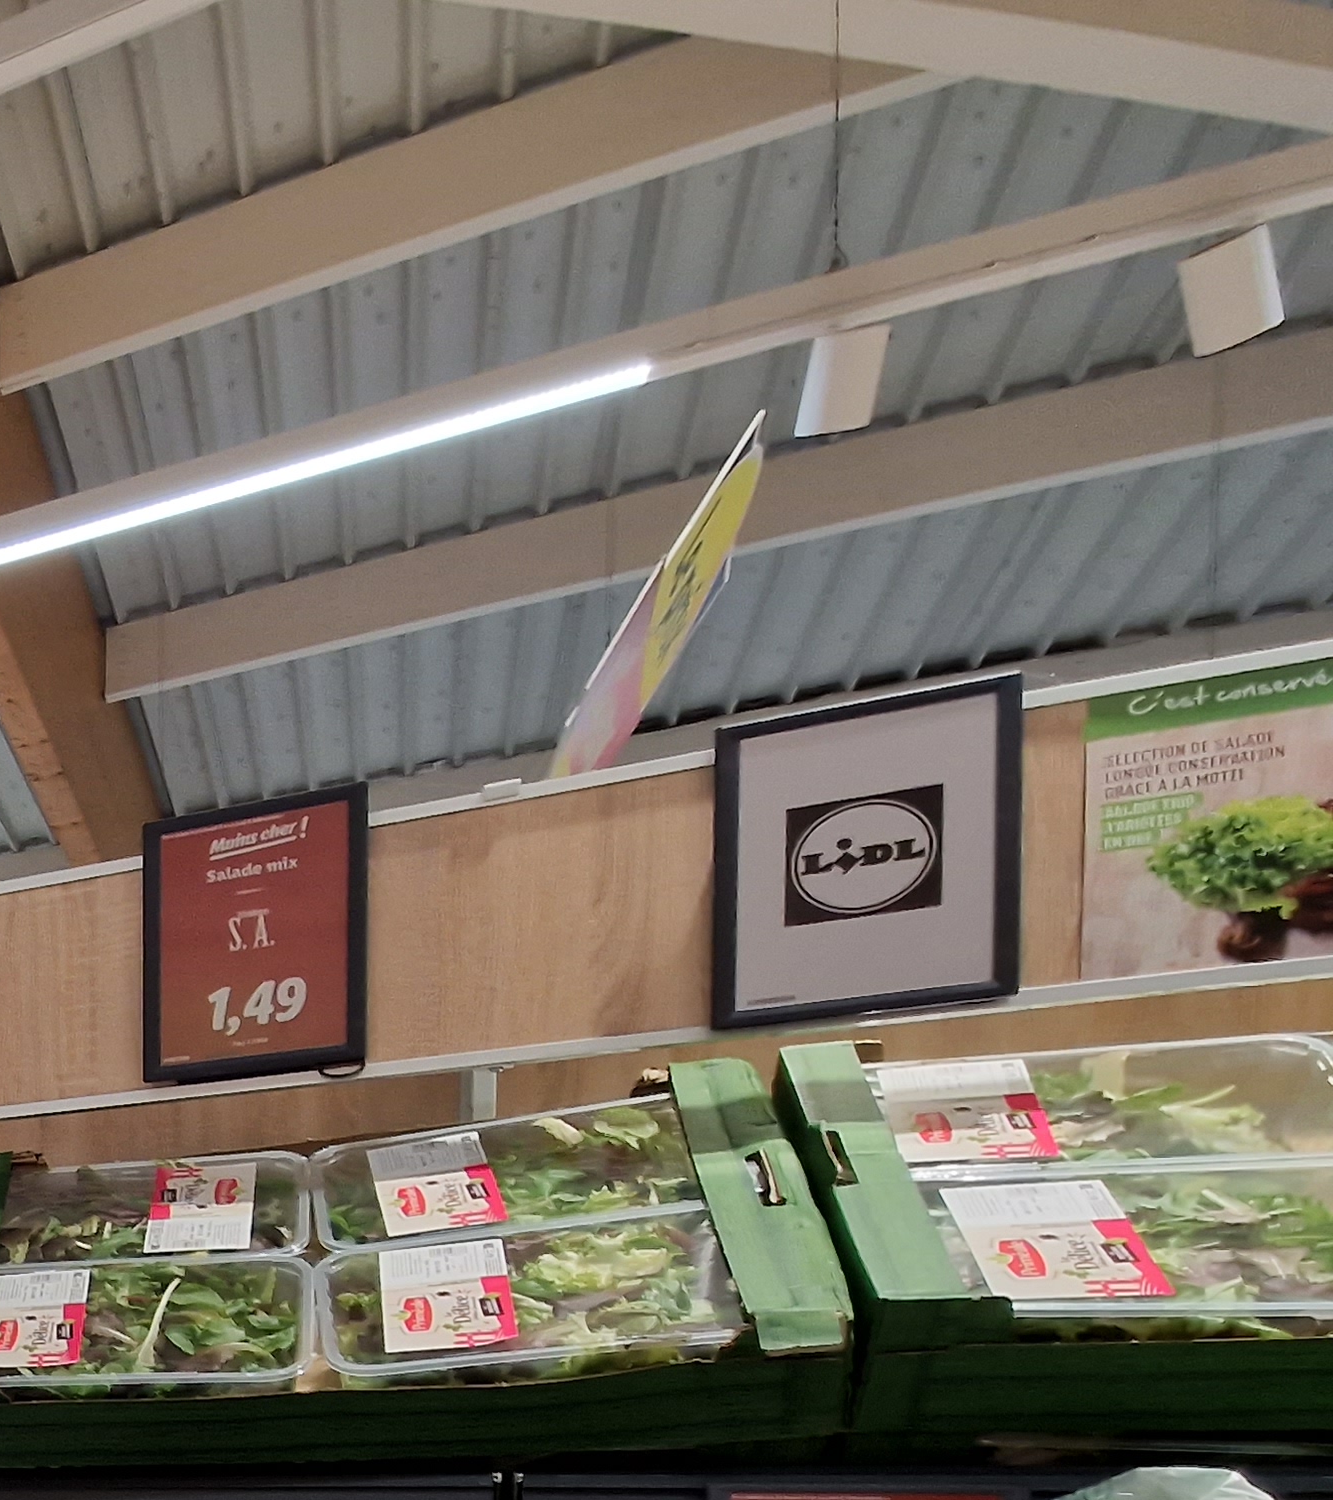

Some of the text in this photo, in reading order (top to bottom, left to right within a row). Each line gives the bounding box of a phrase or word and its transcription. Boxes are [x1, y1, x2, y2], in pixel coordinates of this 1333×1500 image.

[206, 856, 299, 884] Salade mix
[208, 977, 307, 1036] 1,49
